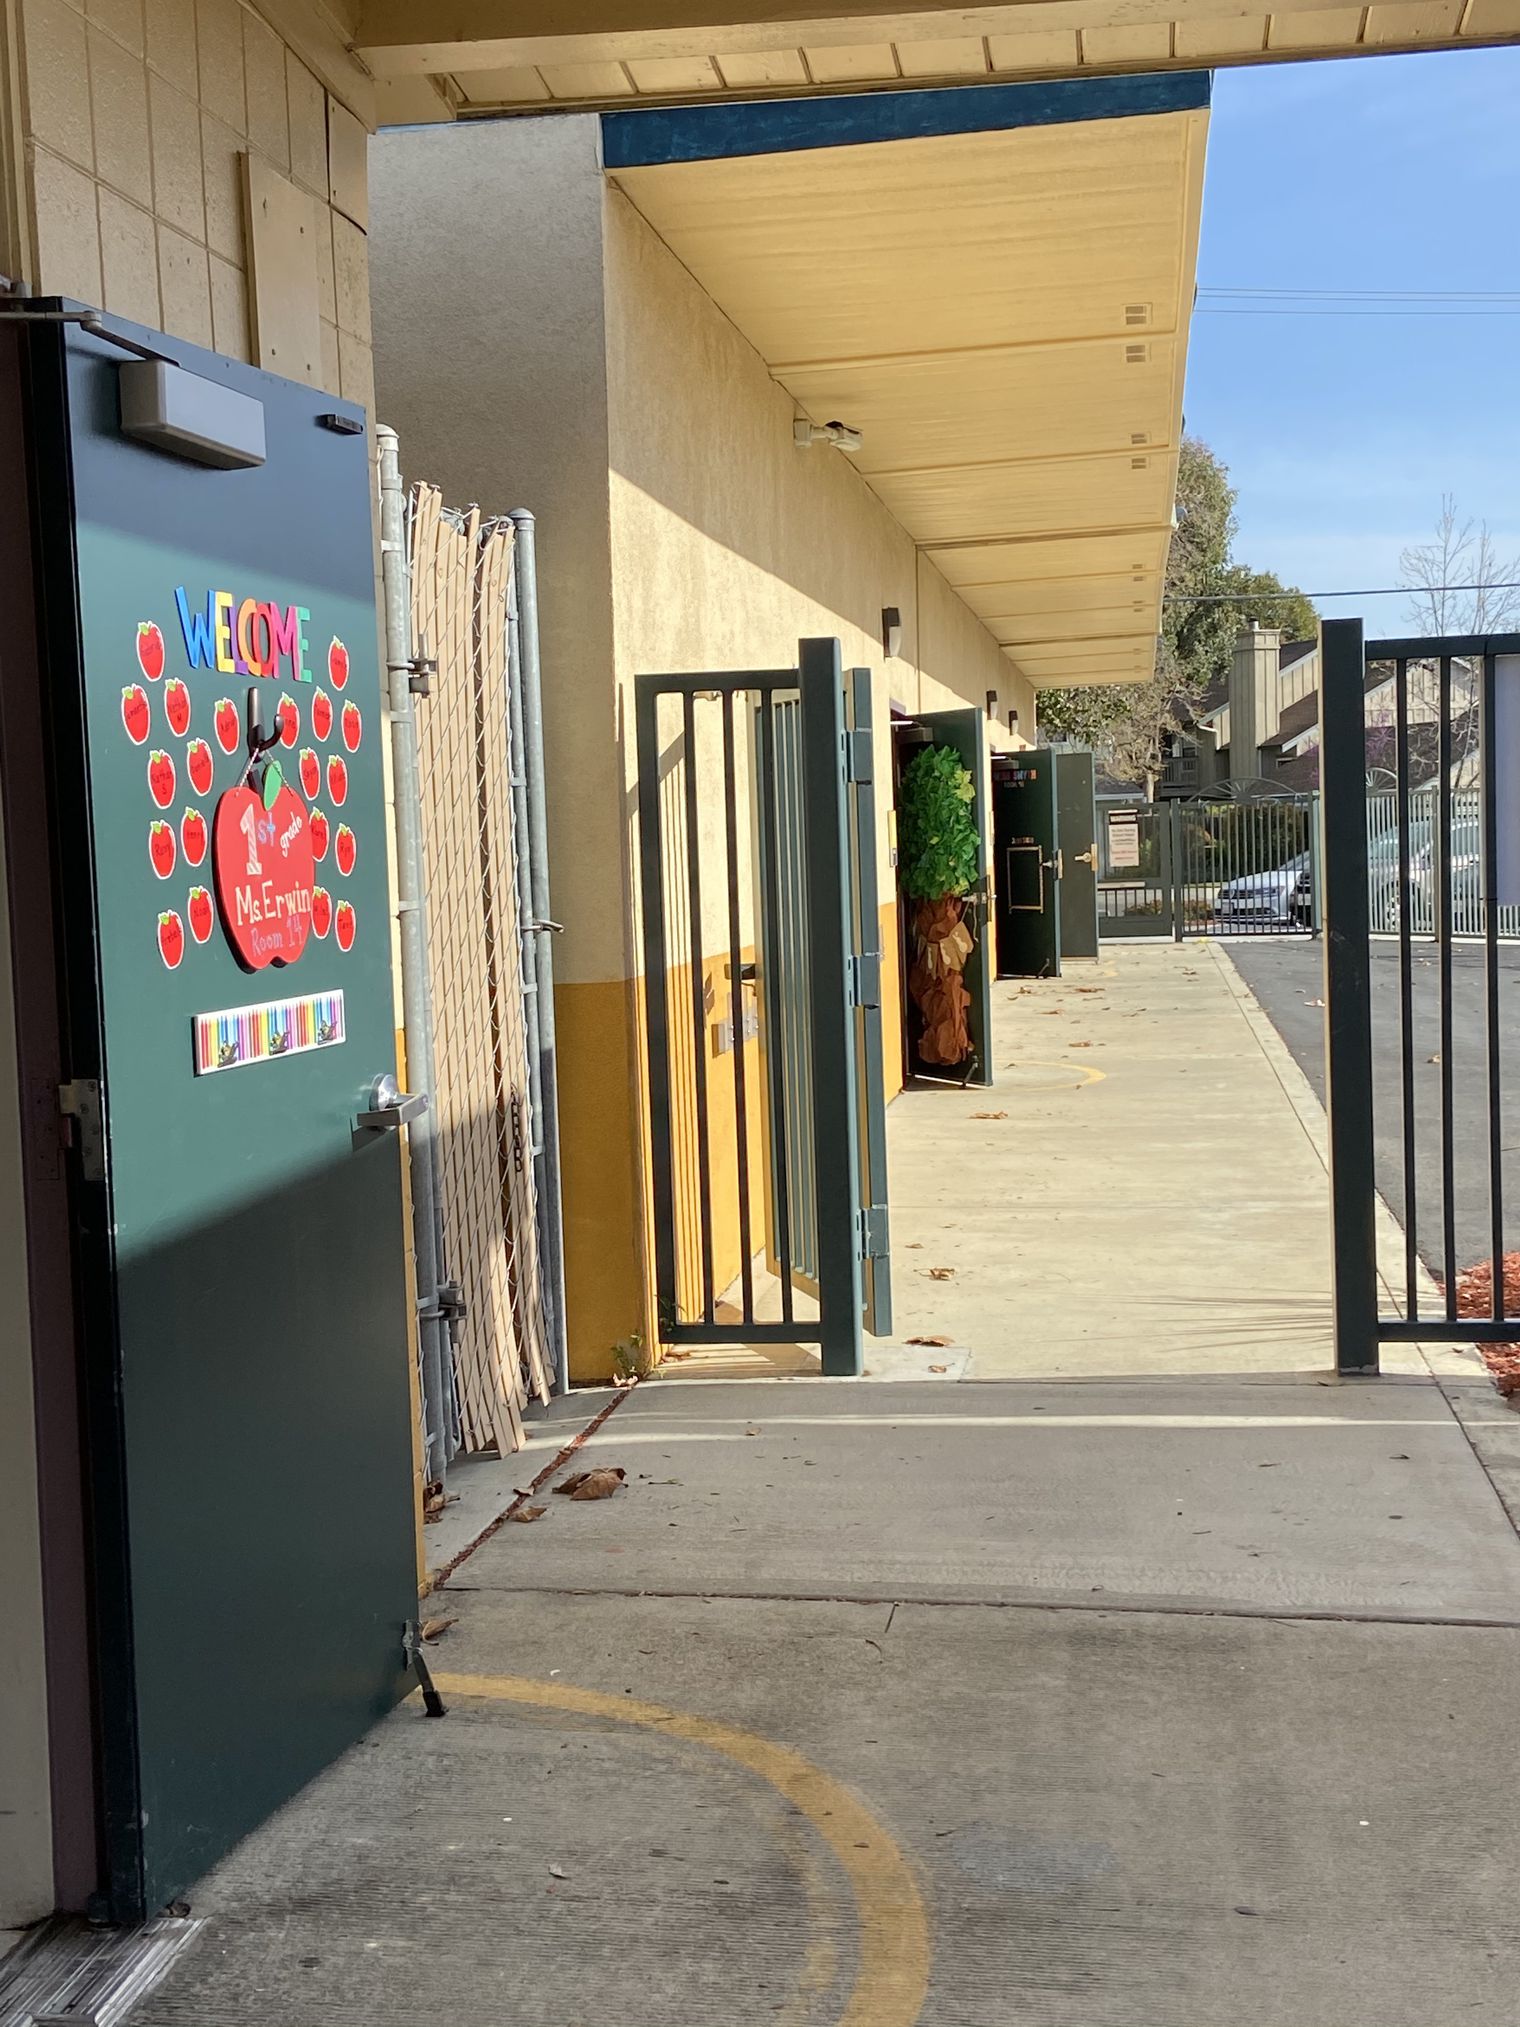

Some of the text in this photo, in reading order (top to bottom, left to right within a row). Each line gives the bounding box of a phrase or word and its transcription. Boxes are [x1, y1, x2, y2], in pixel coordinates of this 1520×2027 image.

[175, 586, 312, 682] WELCOME
[240, 803, 303, 875] 1st grade
[262, 880, 311, 919] Erwin
[251, 915, 304, 956] Room 14
